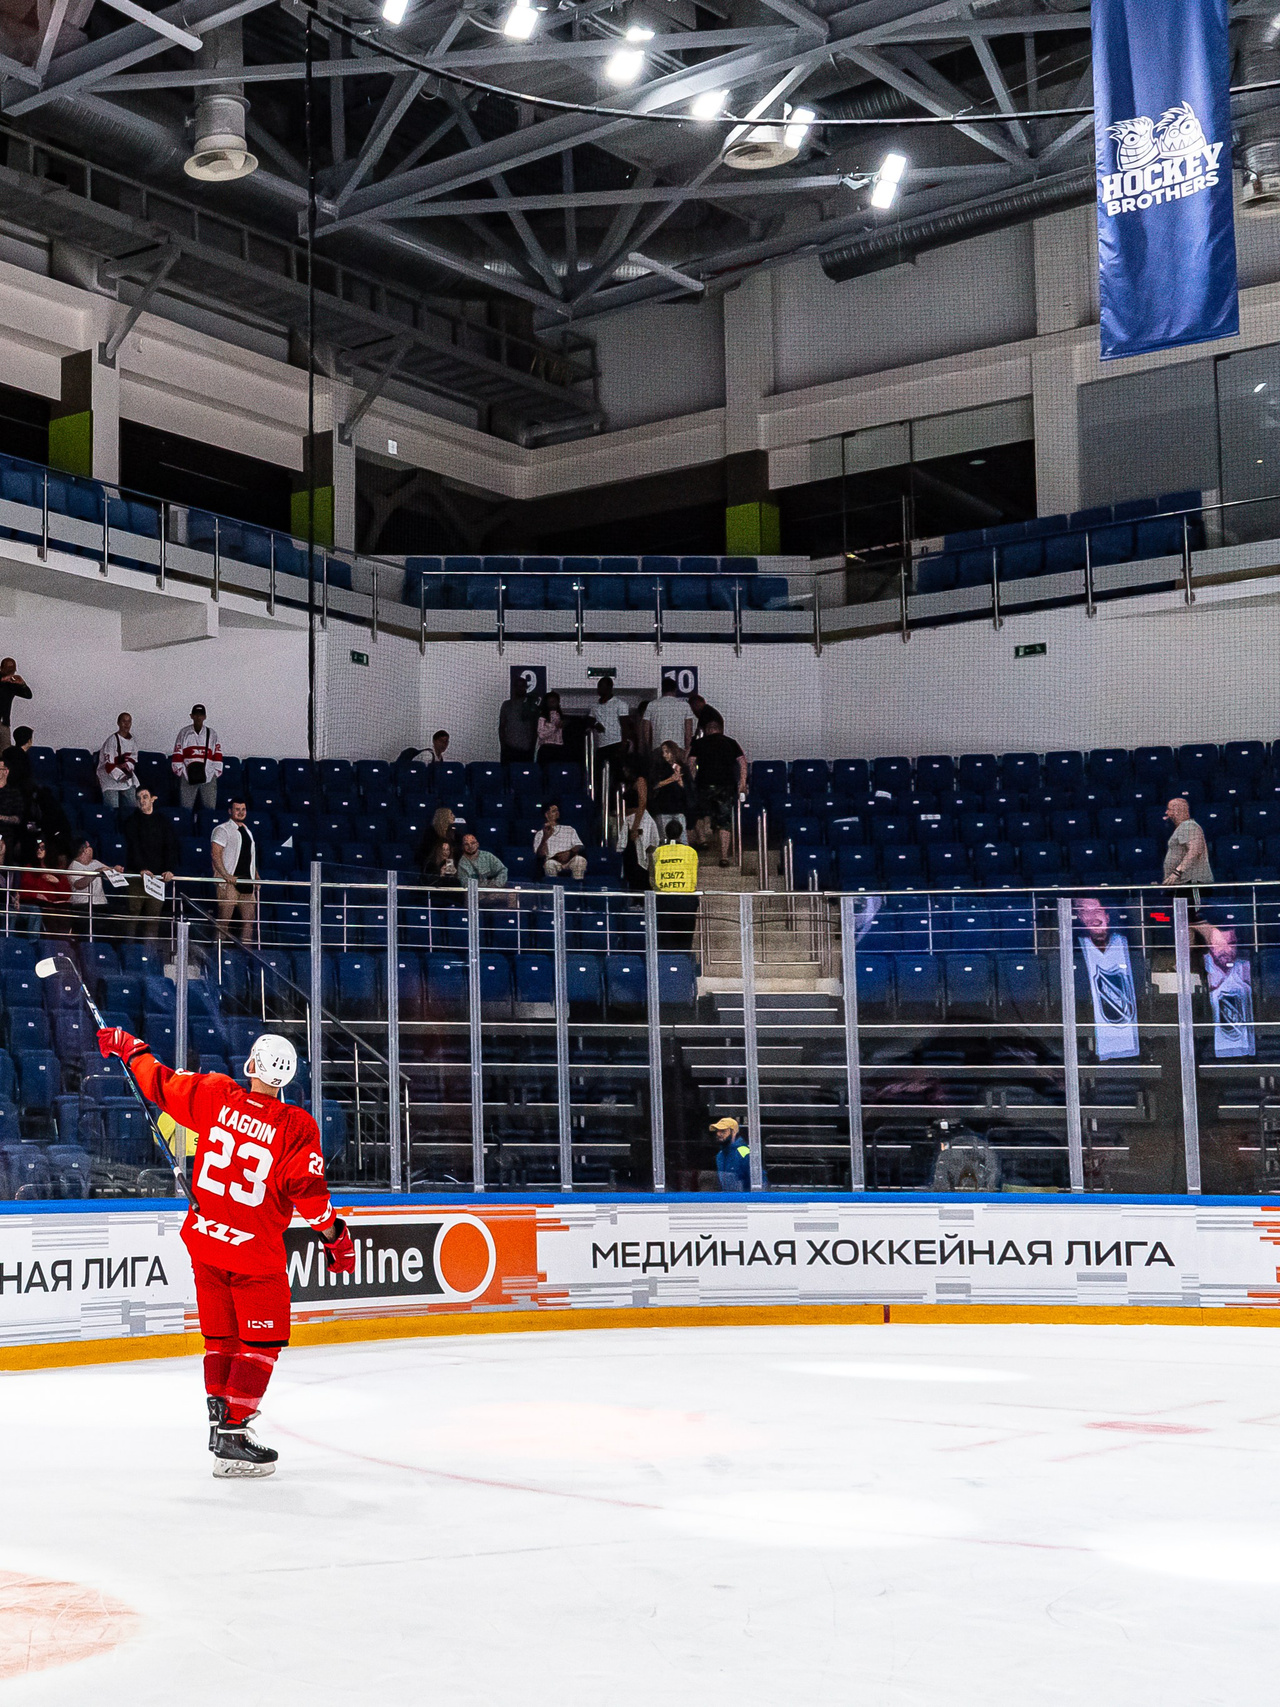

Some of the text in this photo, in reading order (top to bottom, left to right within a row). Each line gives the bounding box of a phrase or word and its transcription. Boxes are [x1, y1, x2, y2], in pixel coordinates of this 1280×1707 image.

[1100, 141, 1224, 204] HOCKEY
[1106, 170, 1220, 217] BROTHERS
[520, 669, 537, 694] 9
[659, 881, 686, 889] SAFETY
[217, 1104, 277, 1145] KAGDIN
[196, 1125, 274, 1208] 23
[191, 1212, 255, 1247] X17
[81, 1255, 170, 1291] ЛИГА
[286, 1237, 425, 1289] Wiline
[591, 1233, 1176, 1274] МЕДИЙНАЯ ХОККЕЙНАЯ ЛИГА
